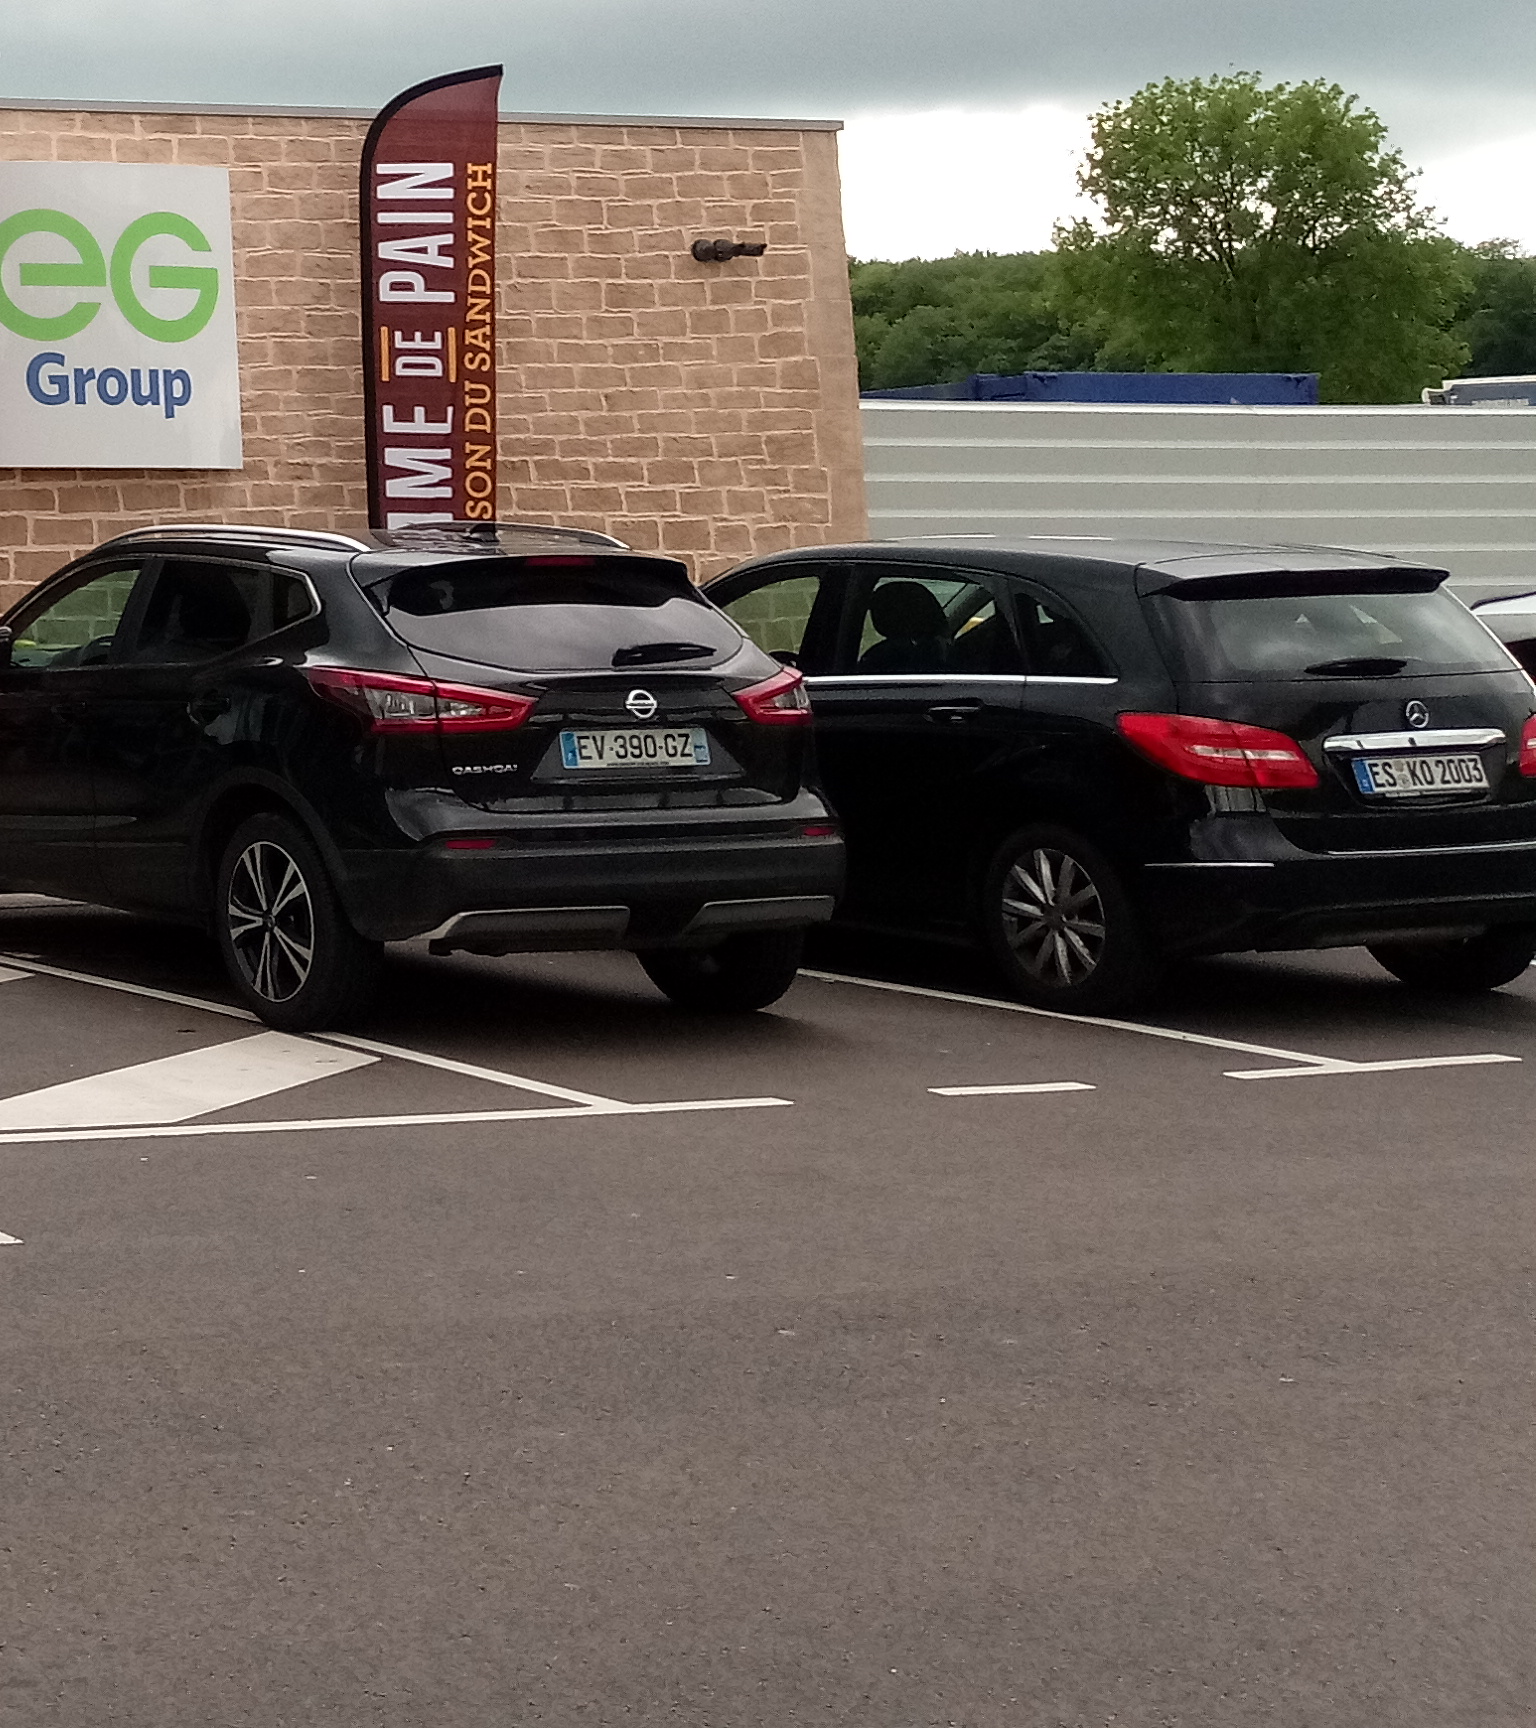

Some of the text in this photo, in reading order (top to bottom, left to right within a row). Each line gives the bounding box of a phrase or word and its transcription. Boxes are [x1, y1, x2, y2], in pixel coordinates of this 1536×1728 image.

[376, 162, 455, 303] PAIN
[394, 330, 444, 377] DE
[463, 162, 493, 520] SON DU SANDWICH
[26, 351, 192, 419] Group
[1367, 762, 1397, 788] ES
[1434, 758, 1484, 784] 2003
